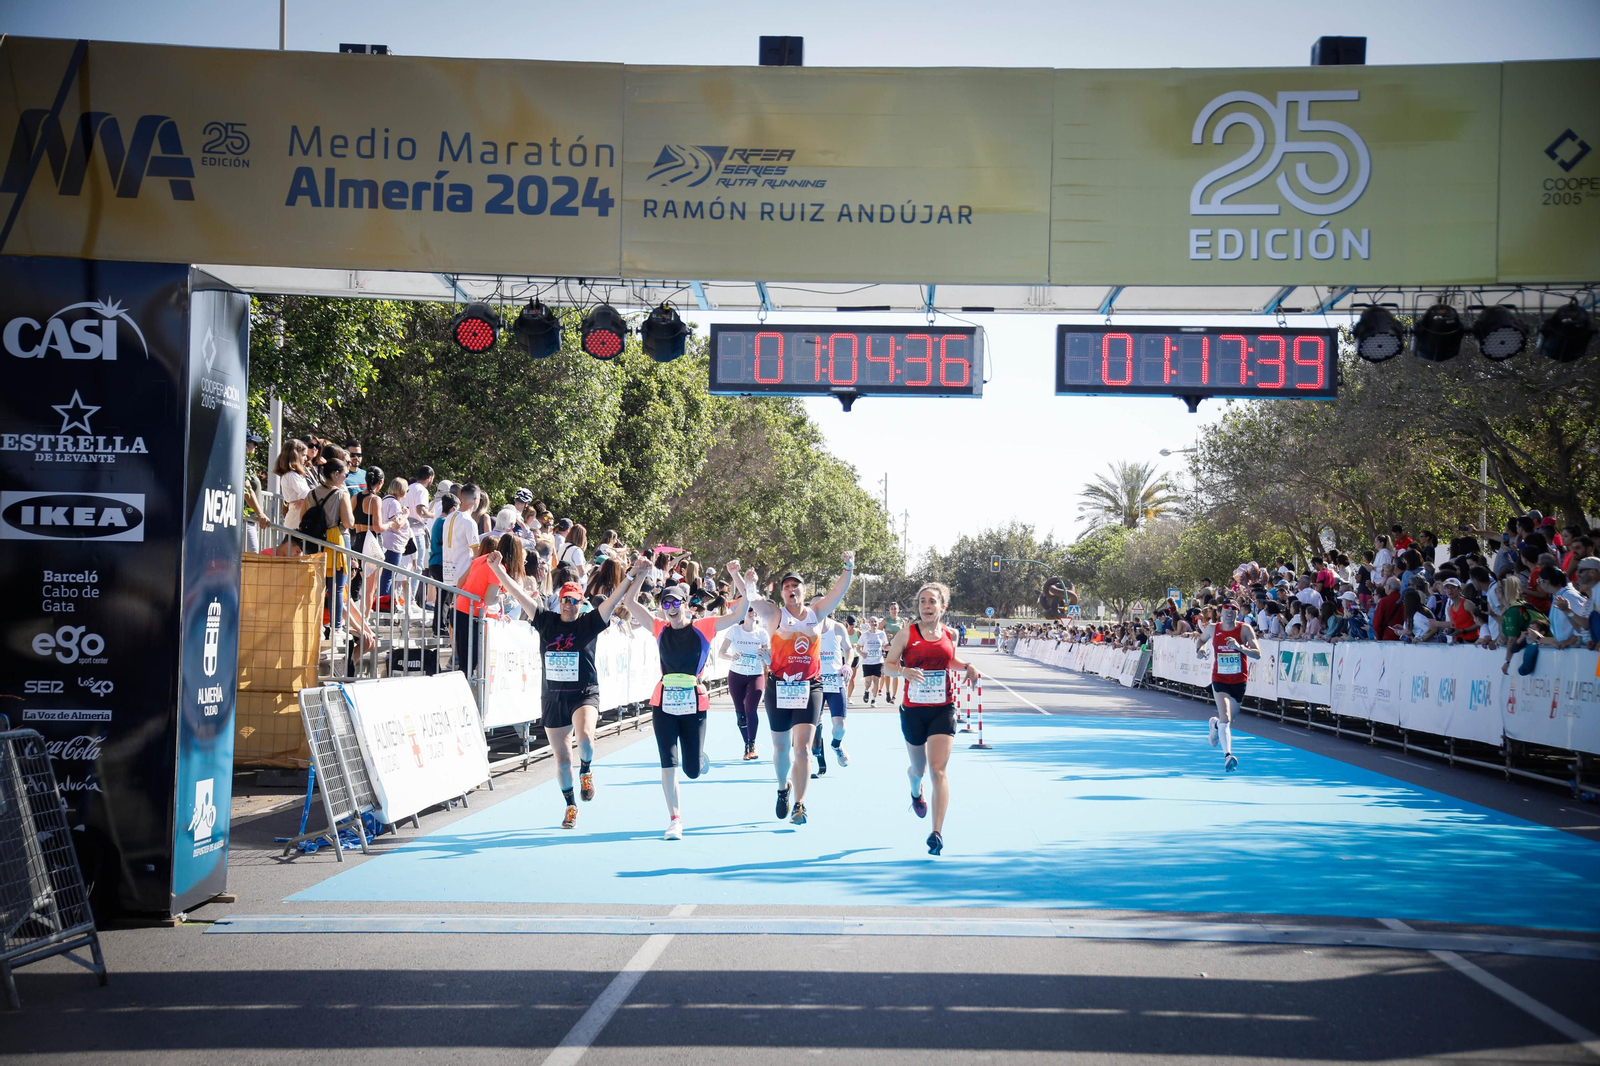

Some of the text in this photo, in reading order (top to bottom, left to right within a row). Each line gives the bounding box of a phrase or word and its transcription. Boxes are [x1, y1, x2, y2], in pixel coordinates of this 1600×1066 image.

[202, 121, 250, 155] 25
[288, 125, 614, 167] Medio Maratón
[728, 148, 796, 164] RFEA
[1190, 90, 1371, 215] 25
[201, 156, 250, 168] EDICIÓN
[721, 165, 788, 177] SERIES
[285, 166, 615, 217] Almería 2024
[715, 178, 827, 189] RUTA RUNNING
[1542, 192, 1582, 205] 2005
[643, 196, 972, 224] RAMÓN RUIZ ANDÚJAR
[1189, 220, 1370, 260] EDICIÓN
[3, 315, 117, 360] CASI
[754, 332, 970, 387] 01:04:36
[1102, 333, 1325, 389] 01:17:39
[201, 393, 216, 410] 2005
[0, 433, 149, 454] ESTRELLA
[34, 453, 115, 464] DE LEVANTE
[21, 505, 129, 527] IKEA
[43, 570, 98, 583] Barceló
[42, 585, 100, 598] Cabo de
[42, 600, 75, 612] Gata
[32, 625, 105, 664] ego
[78, 657, 108, 665] sport center
[549, 657, 576, 666] 5695
[24, 680, 64, 693] SER
[198, 683, 224, 705] ALMERÍA
[780, 686, 807, 695] 5069
[666, 690, 692, 700] 5697
[24, 711, 110, 721] La Voz de Almería
[26, 774, 103, 793] Analucía
